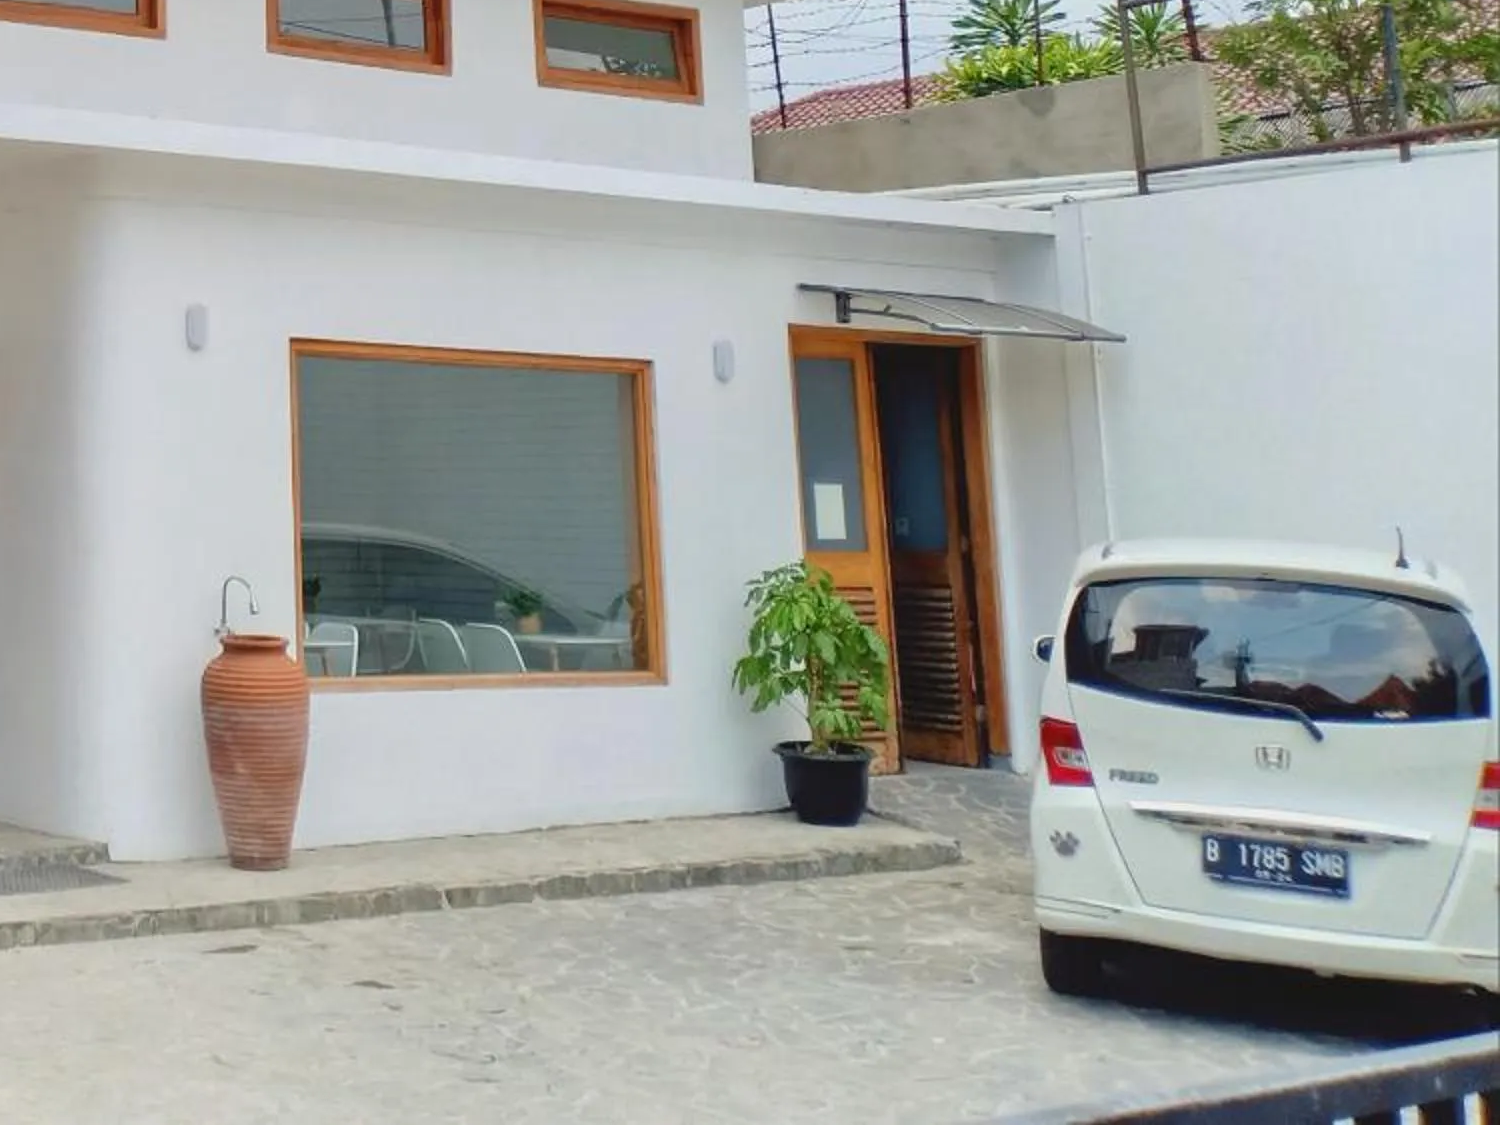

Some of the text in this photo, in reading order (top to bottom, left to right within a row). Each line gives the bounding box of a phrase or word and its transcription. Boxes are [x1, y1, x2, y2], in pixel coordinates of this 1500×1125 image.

[1206, 838, 1219, 862] B
[1238, 843, 1291, 872] 1785
[1301, 850, 1345, 879] SMB
